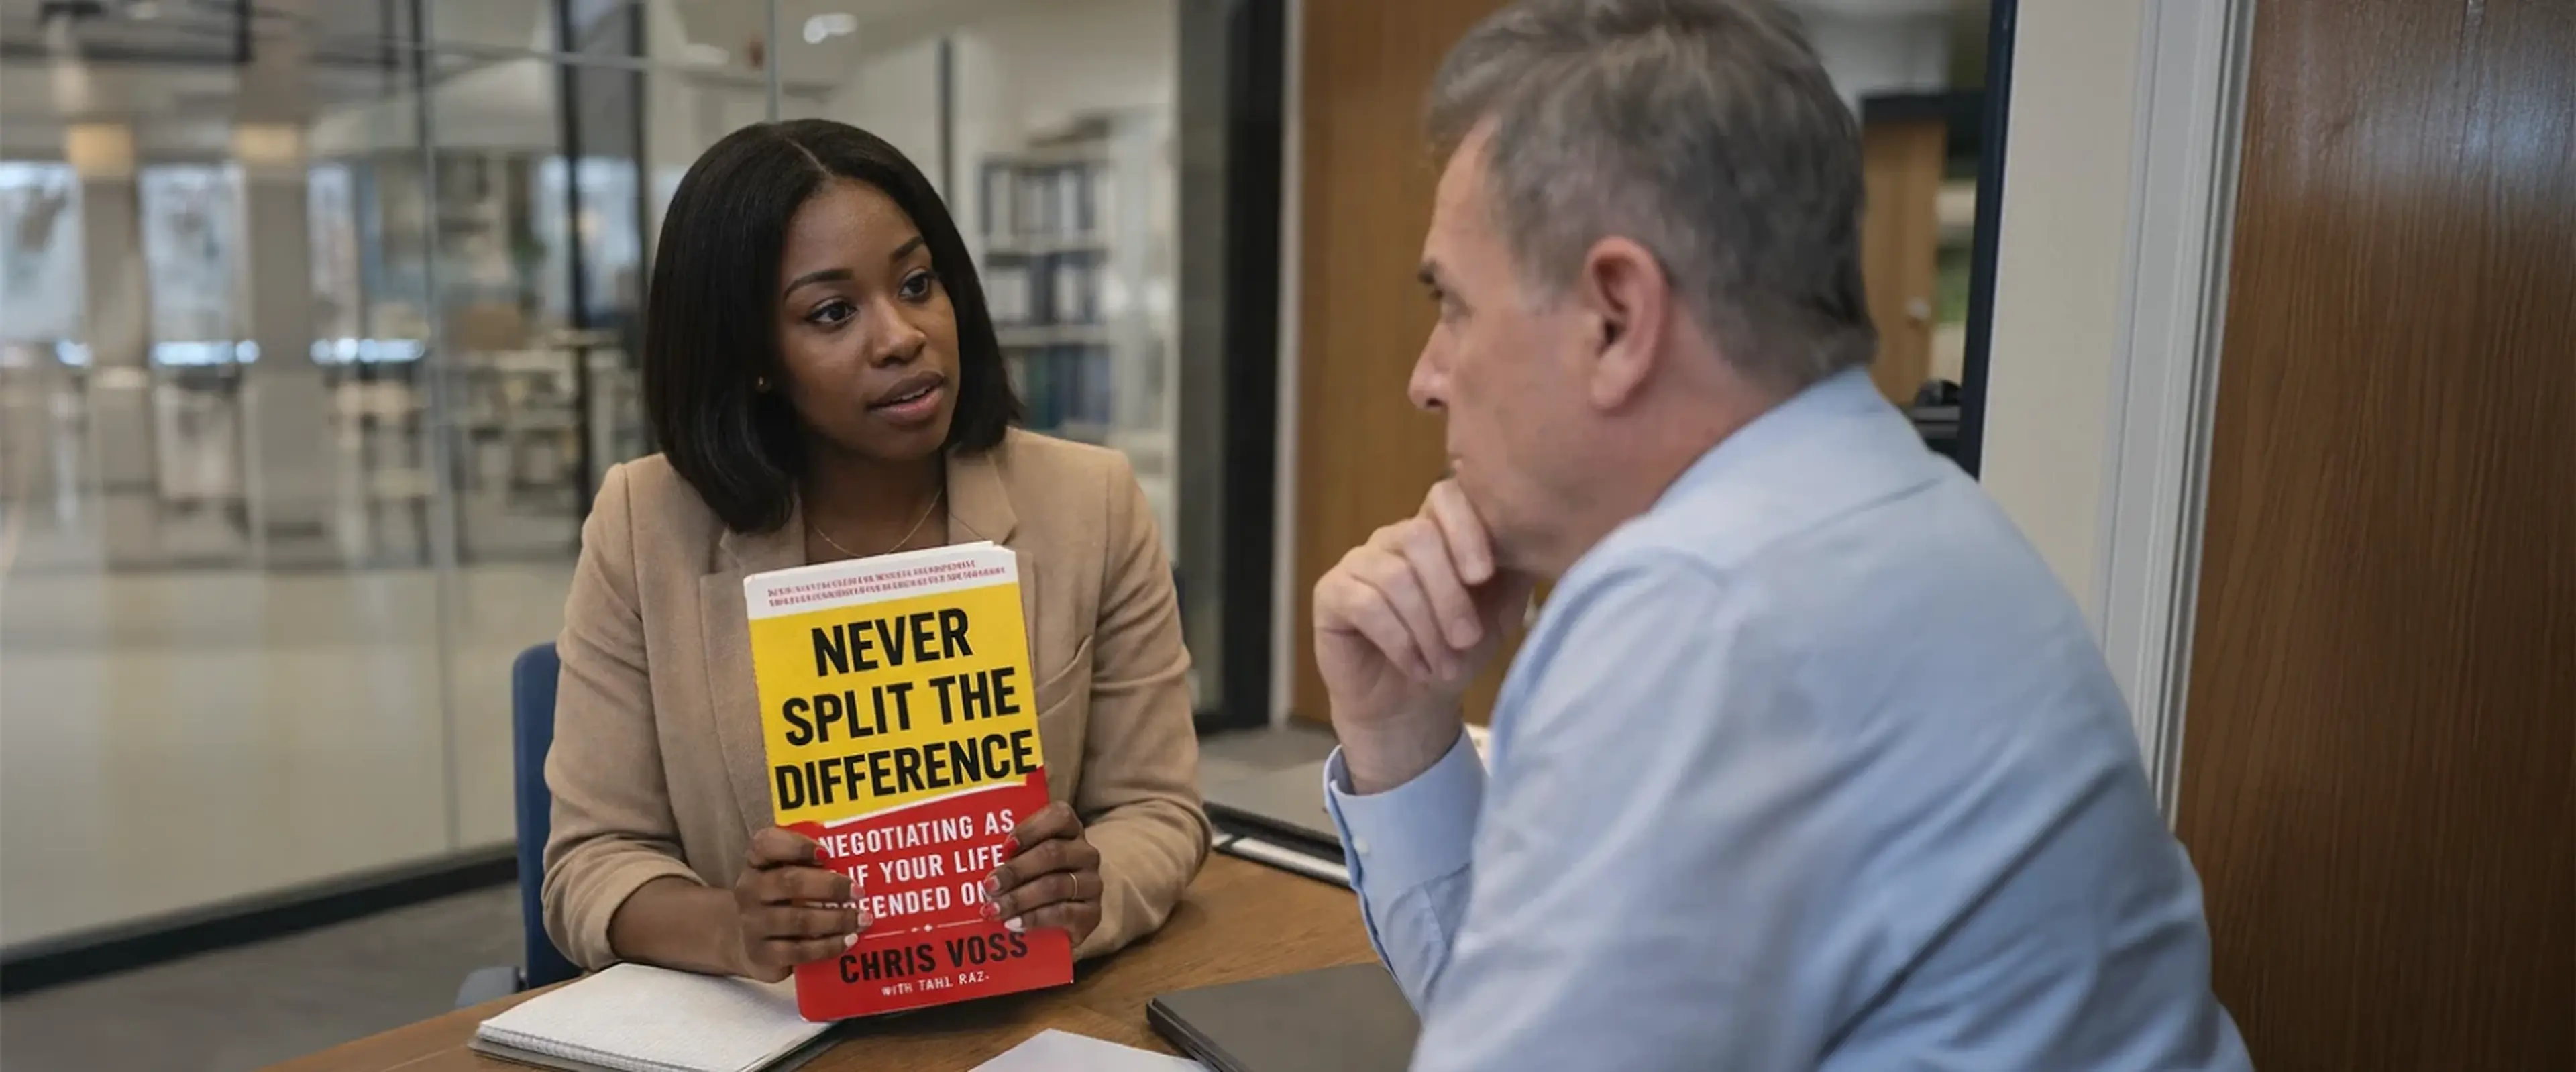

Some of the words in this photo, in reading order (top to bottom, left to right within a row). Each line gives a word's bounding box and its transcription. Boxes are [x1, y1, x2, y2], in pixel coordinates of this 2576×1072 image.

[812, 608, 973, 677] NEVER
[782, 682, 913, 746] SPLIT
[929, 667, 1020, 725] THE
[775, 729, 1038, 810] DIFFERENCE
[818, 816, 973, 859] NEGOTIATING
[985, 808, 1015, 836] AS
[879, 853, 944, 884] YOUR
[954, 844, 1005, 873] LIFE
[839, 943, 936, 983] CHRIS
[946, 932, 1028, 969] VOSS
[881, 983, 913, 996] WITH
[917, 976, 953, 991] TAHL
